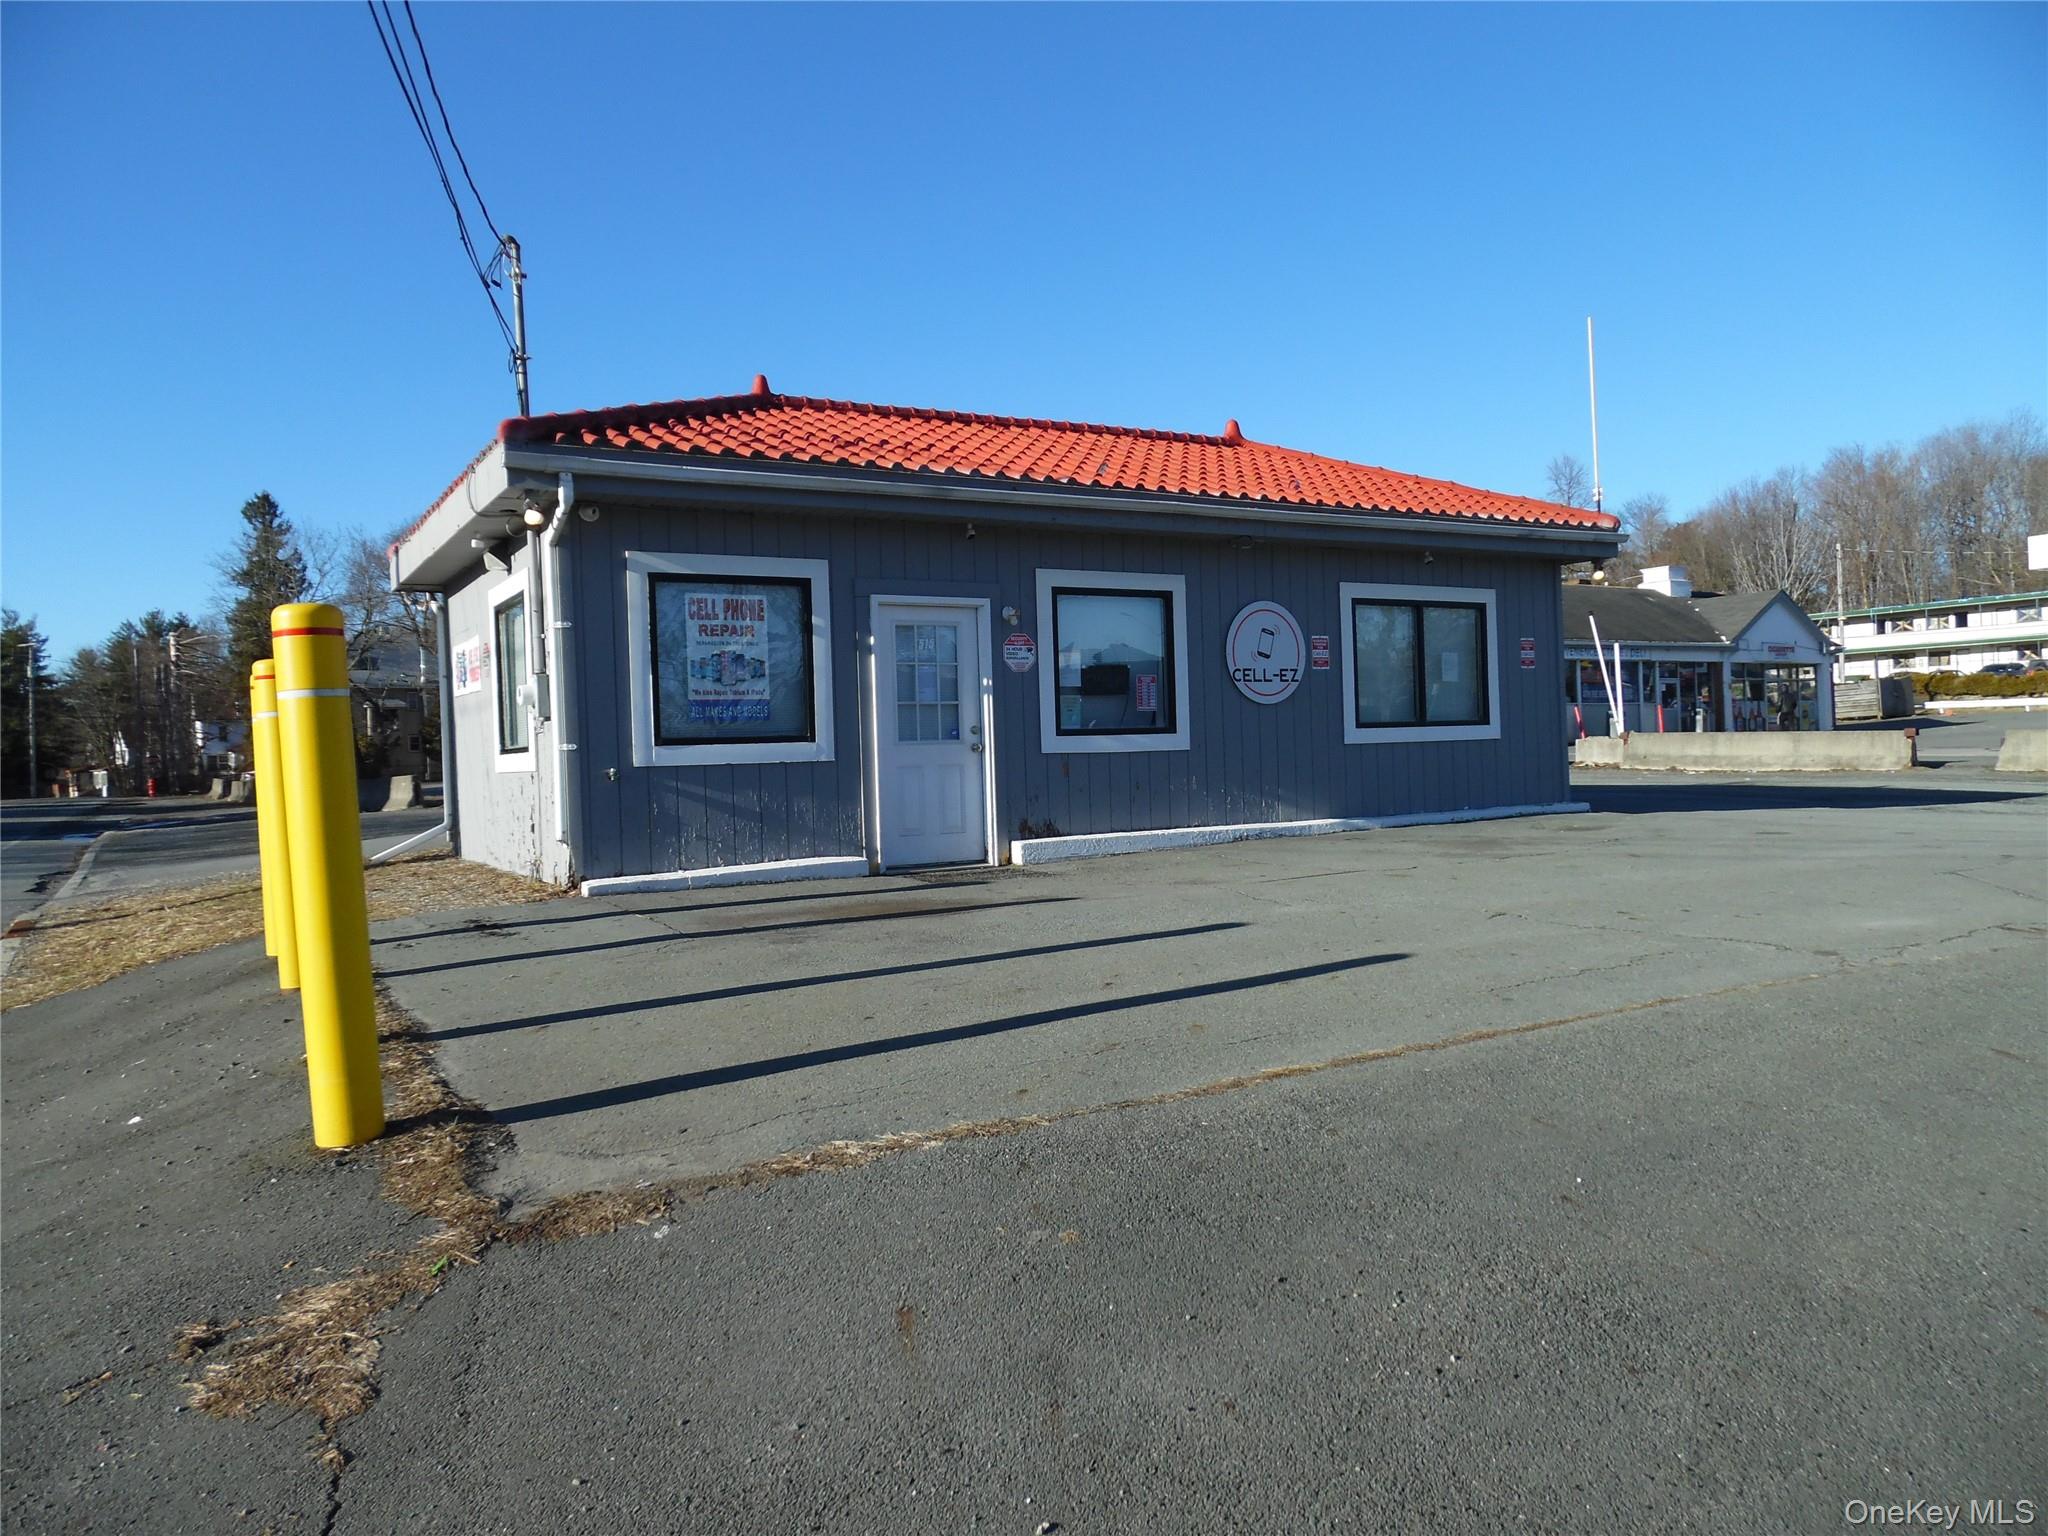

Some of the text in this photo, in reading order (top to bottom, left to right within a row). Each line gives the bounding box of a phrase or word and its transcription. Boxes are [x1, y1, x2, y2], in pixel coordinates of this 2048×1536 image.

[688, 597, 765, 621] CELL PHONE
[699, 624, 756, 637] REPAIR
[1232, 668, 1299, 683] CELL-EZ
